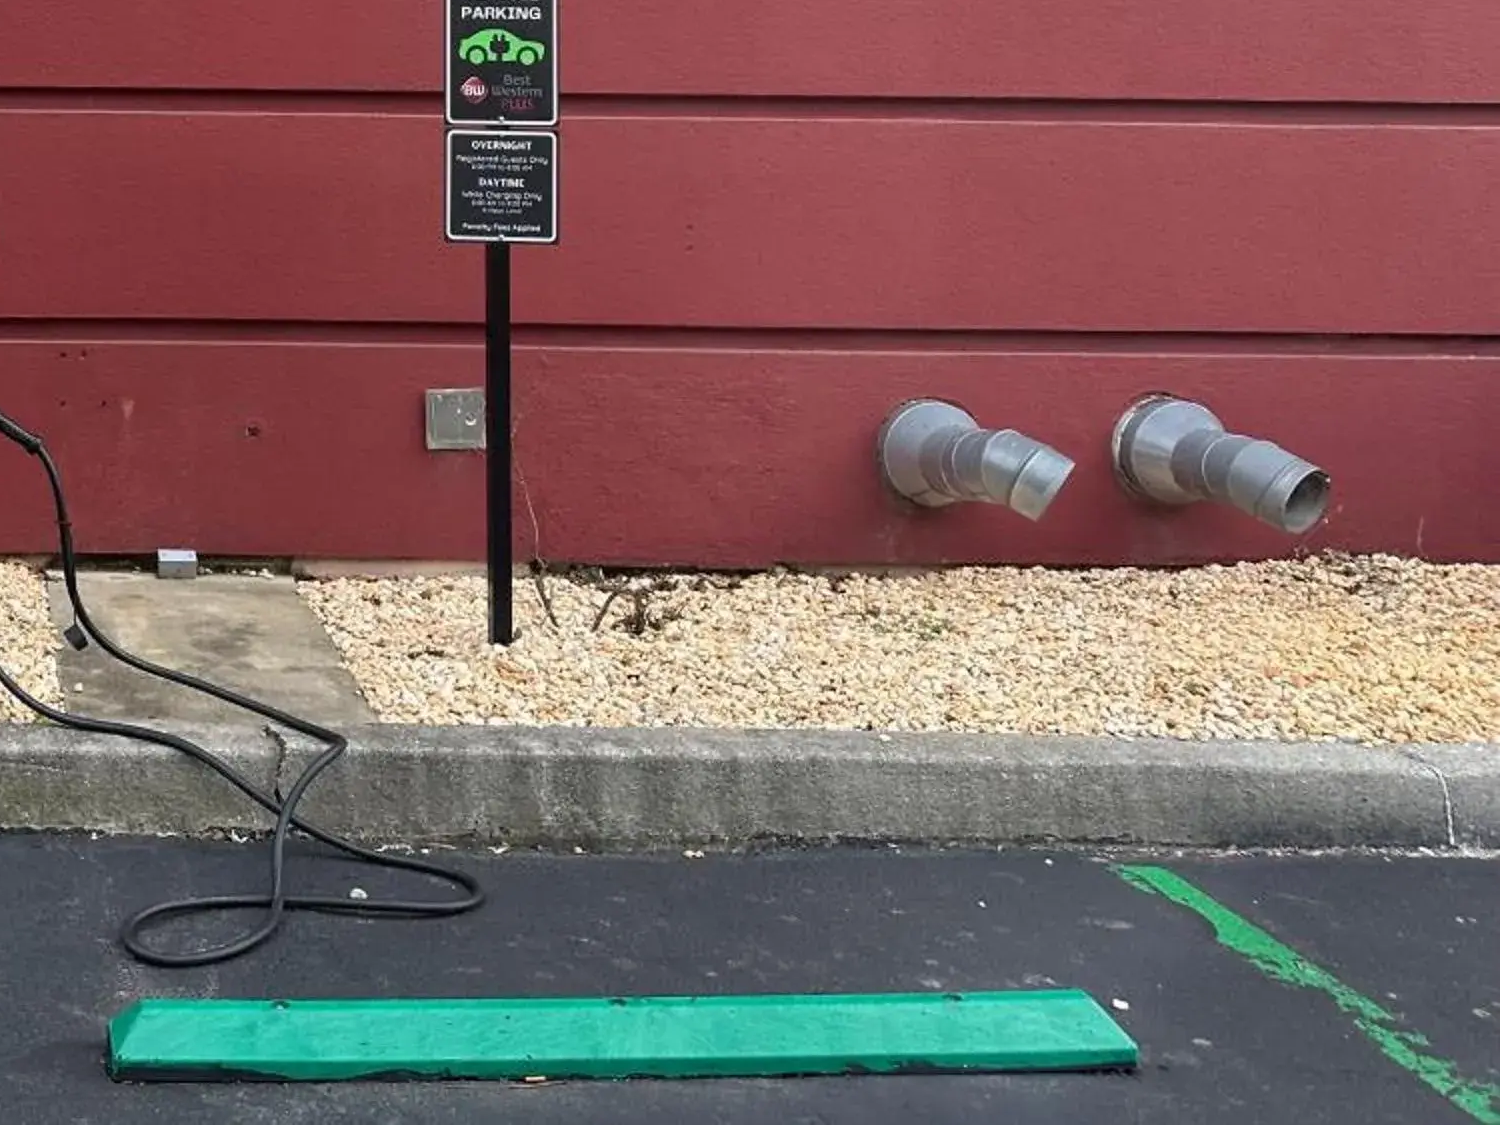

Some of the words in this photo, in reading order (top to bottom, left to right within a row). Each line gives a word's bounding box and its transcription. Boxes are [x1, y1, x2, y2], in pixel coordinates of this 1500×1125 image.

[461, 6, 542, 20] PARKING
[503, 73, 533, 86] Best
[491, 85, 544, 98] Western
[471, 140, 533, 151] OVERNIGHT
[478, 178, 526, 188] DAYTIME
